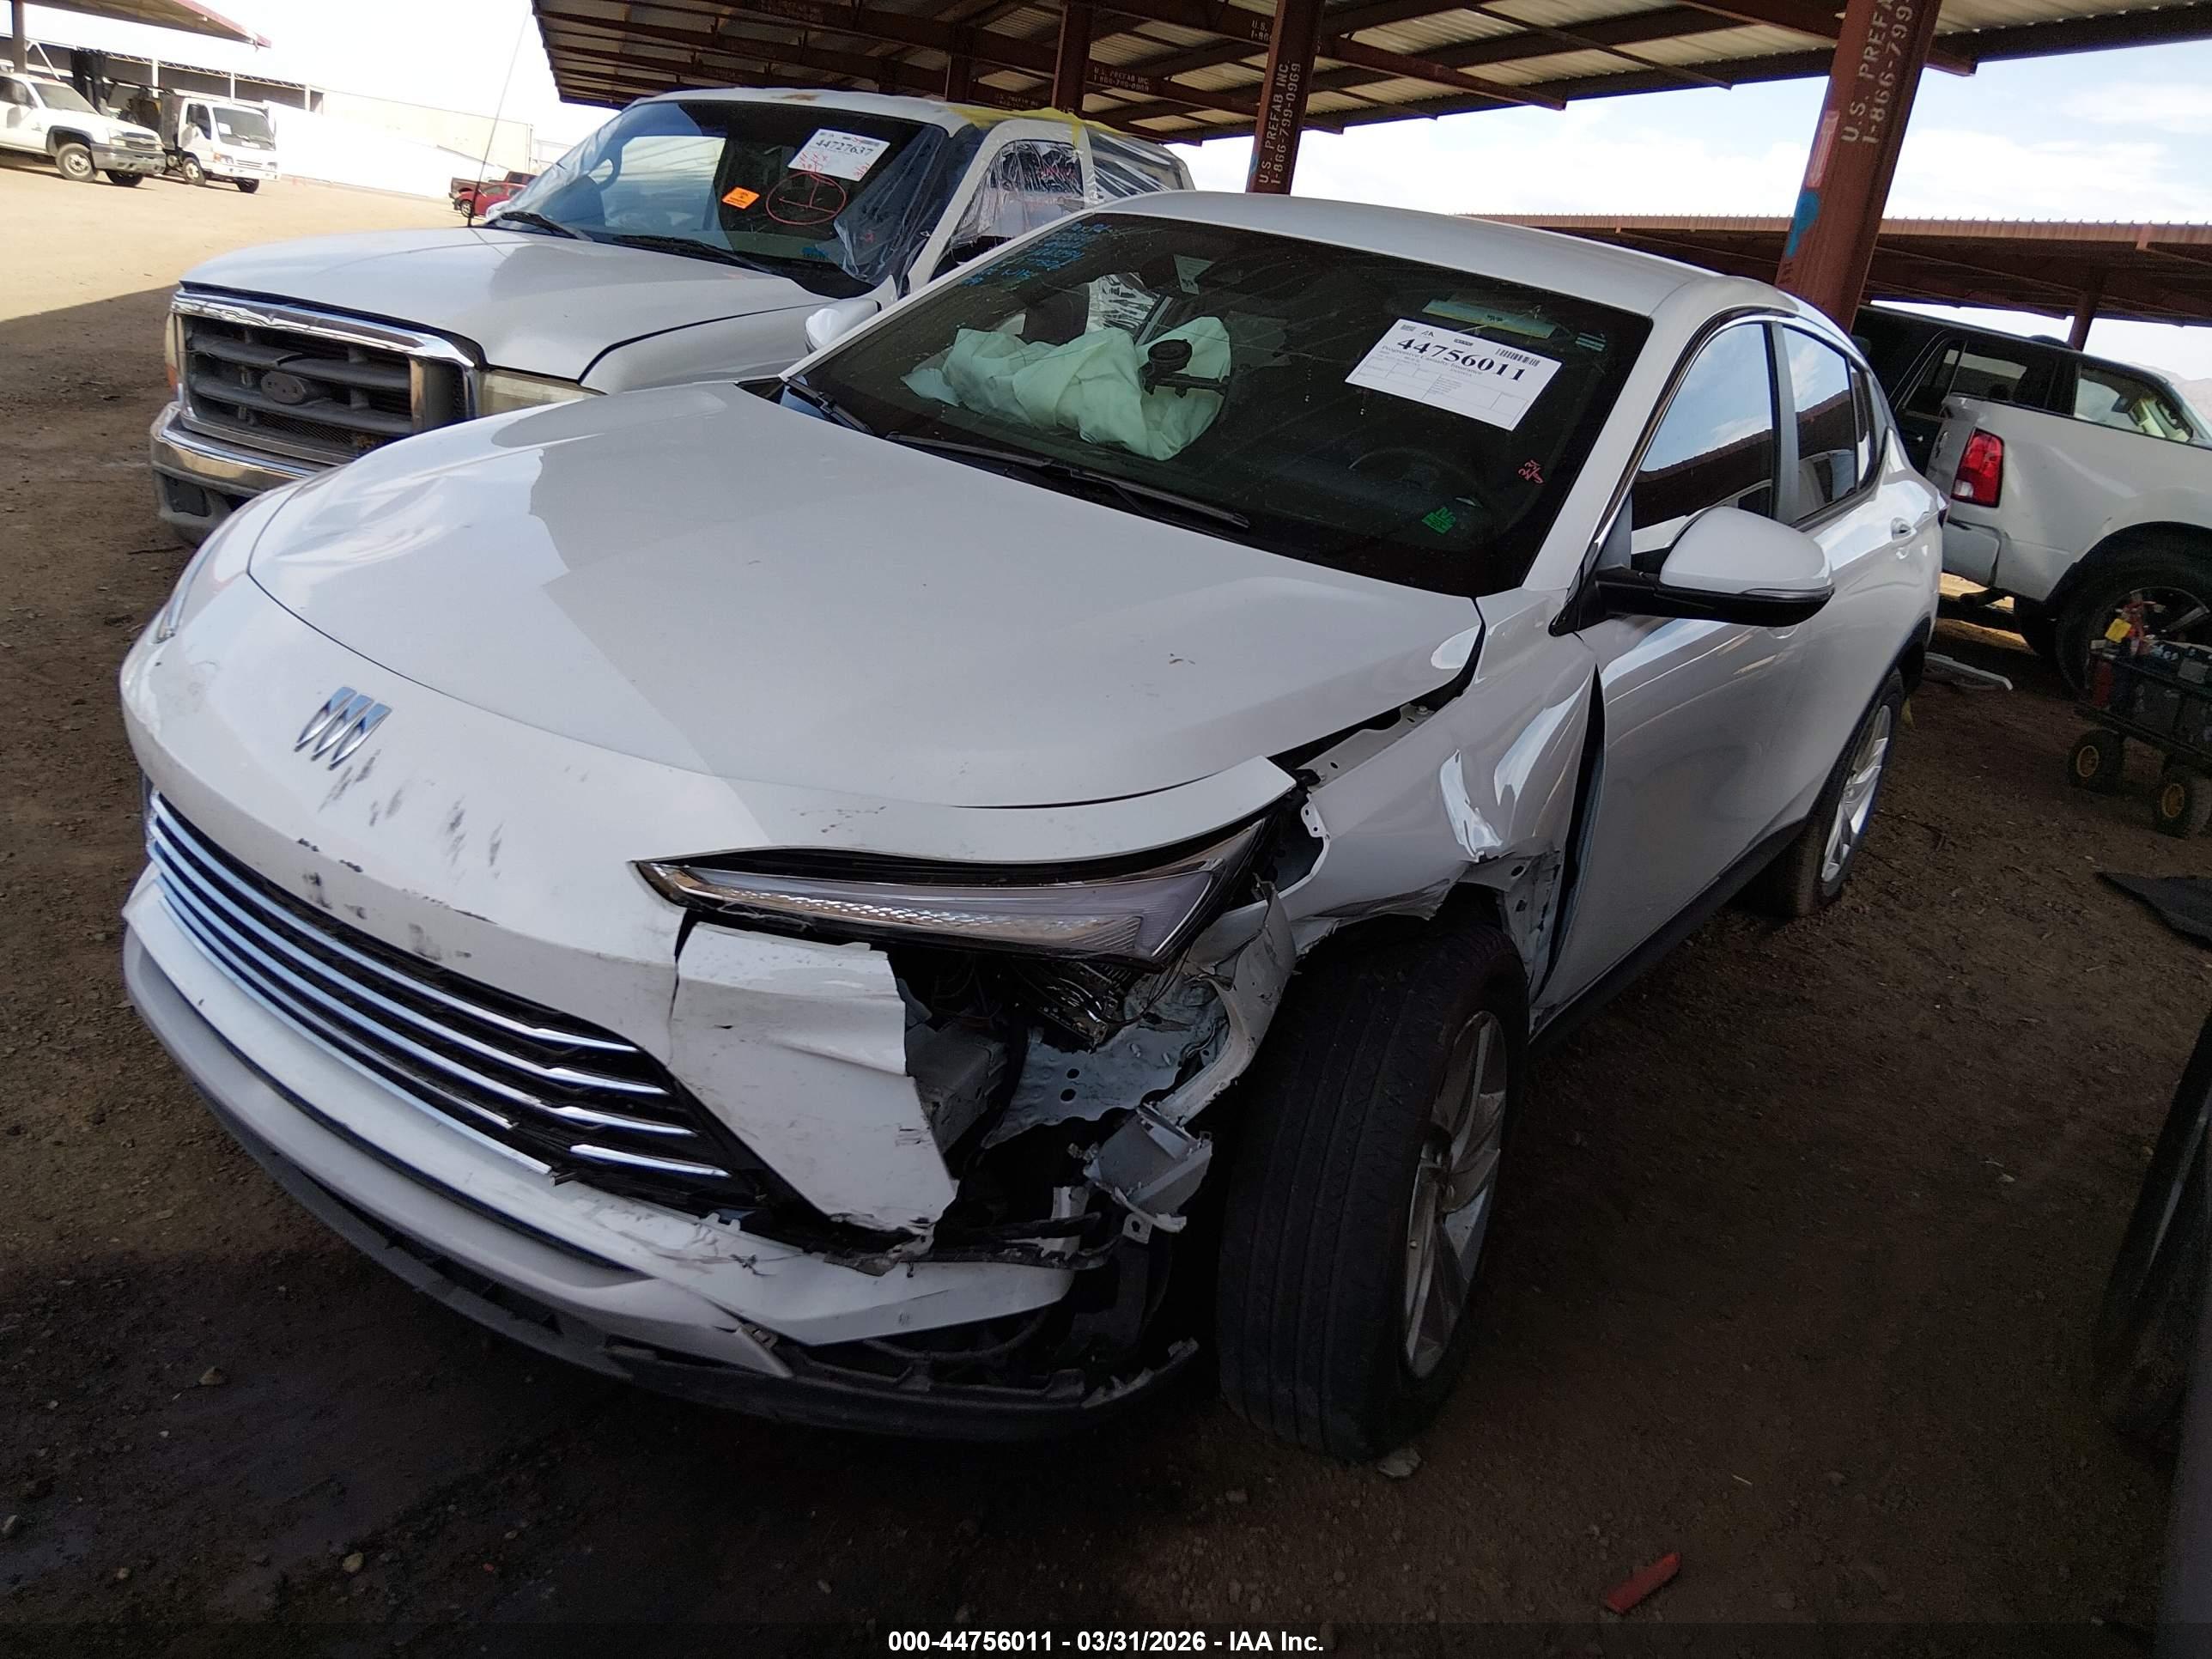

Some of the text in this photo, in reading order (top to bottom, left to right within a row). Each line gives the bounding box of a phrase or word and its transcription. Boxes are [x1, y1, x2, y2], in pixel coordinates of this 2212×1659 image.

[1259, 60, 1291, 184] U.S. PREFAB INC.
[1271, 62, 1301, 185] 1-866-799-0969
[1841, 95, 1869, 143] U.S.
[1396, 337, 1527, 381] 44756011
